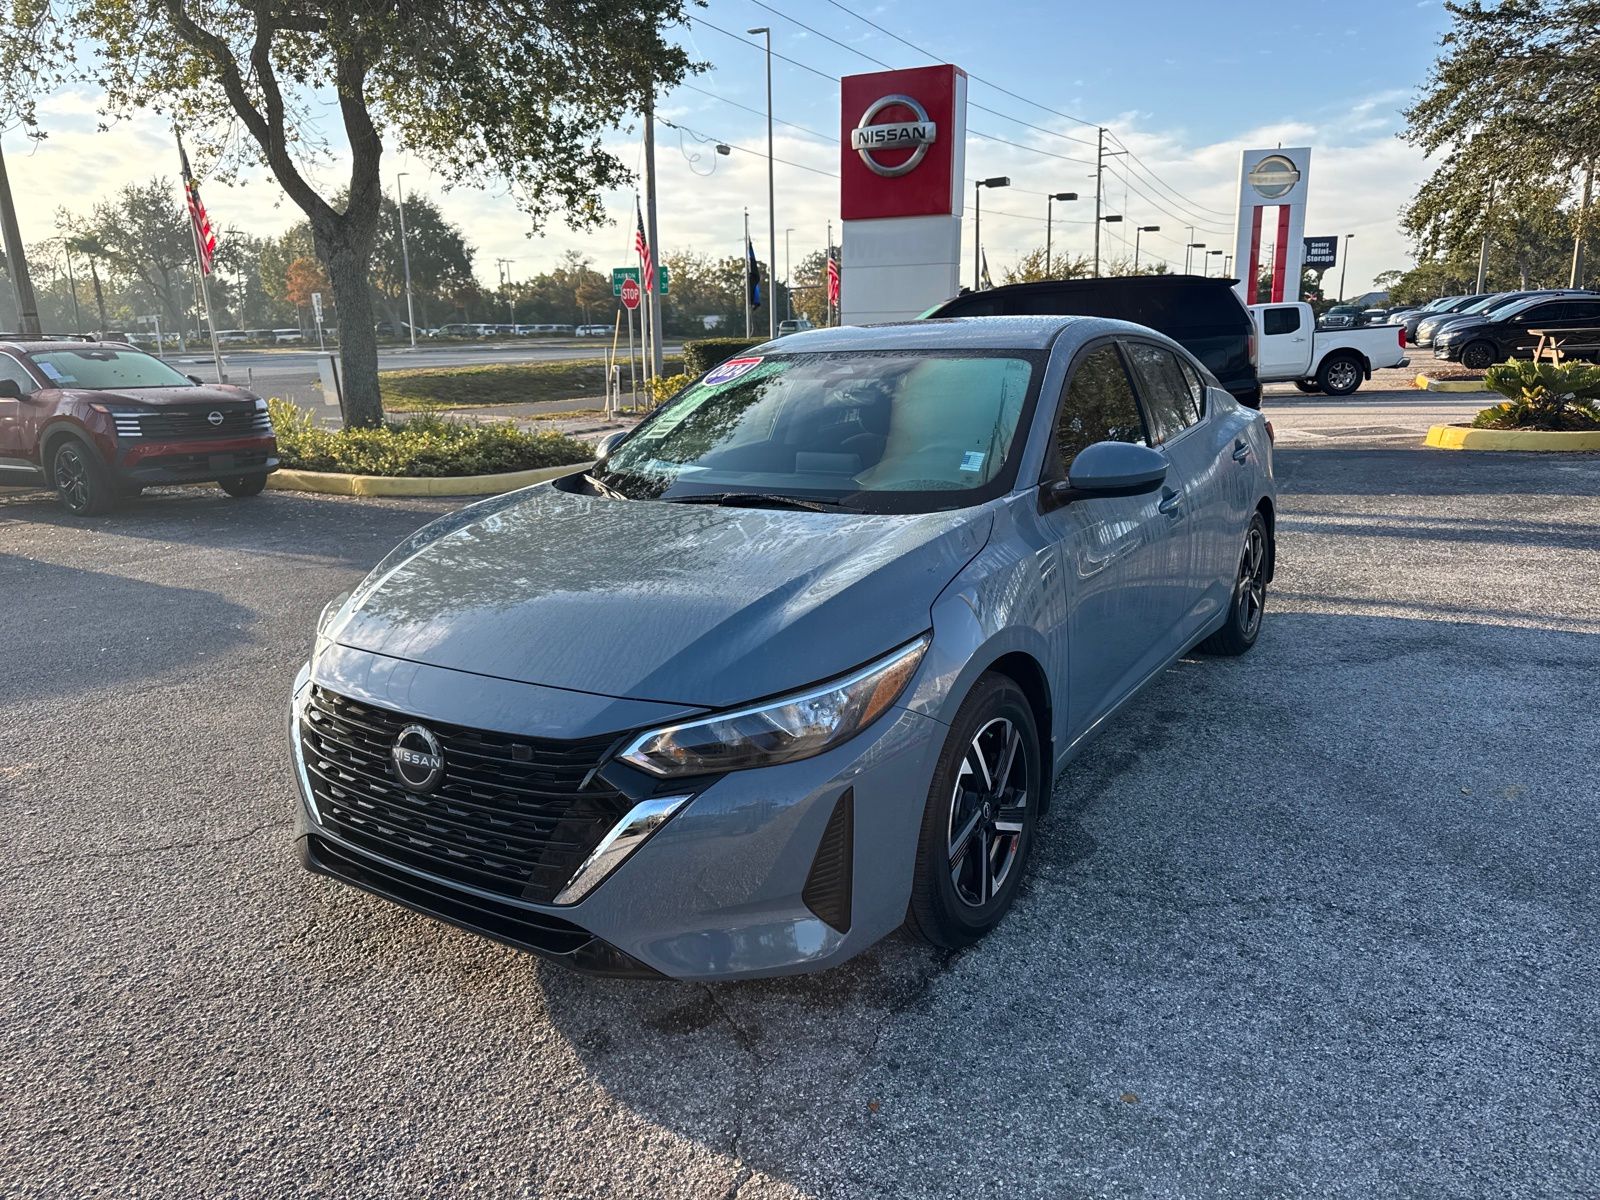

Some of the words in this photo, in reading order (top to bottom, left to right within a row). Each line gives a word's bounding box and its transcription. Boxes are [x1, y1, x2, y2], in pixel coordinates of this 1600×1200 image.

[858, 126, 926, 145] NISSAN
[622, 288, 639, 300] STOP
[393, 748, 440, 767] NISSAN
